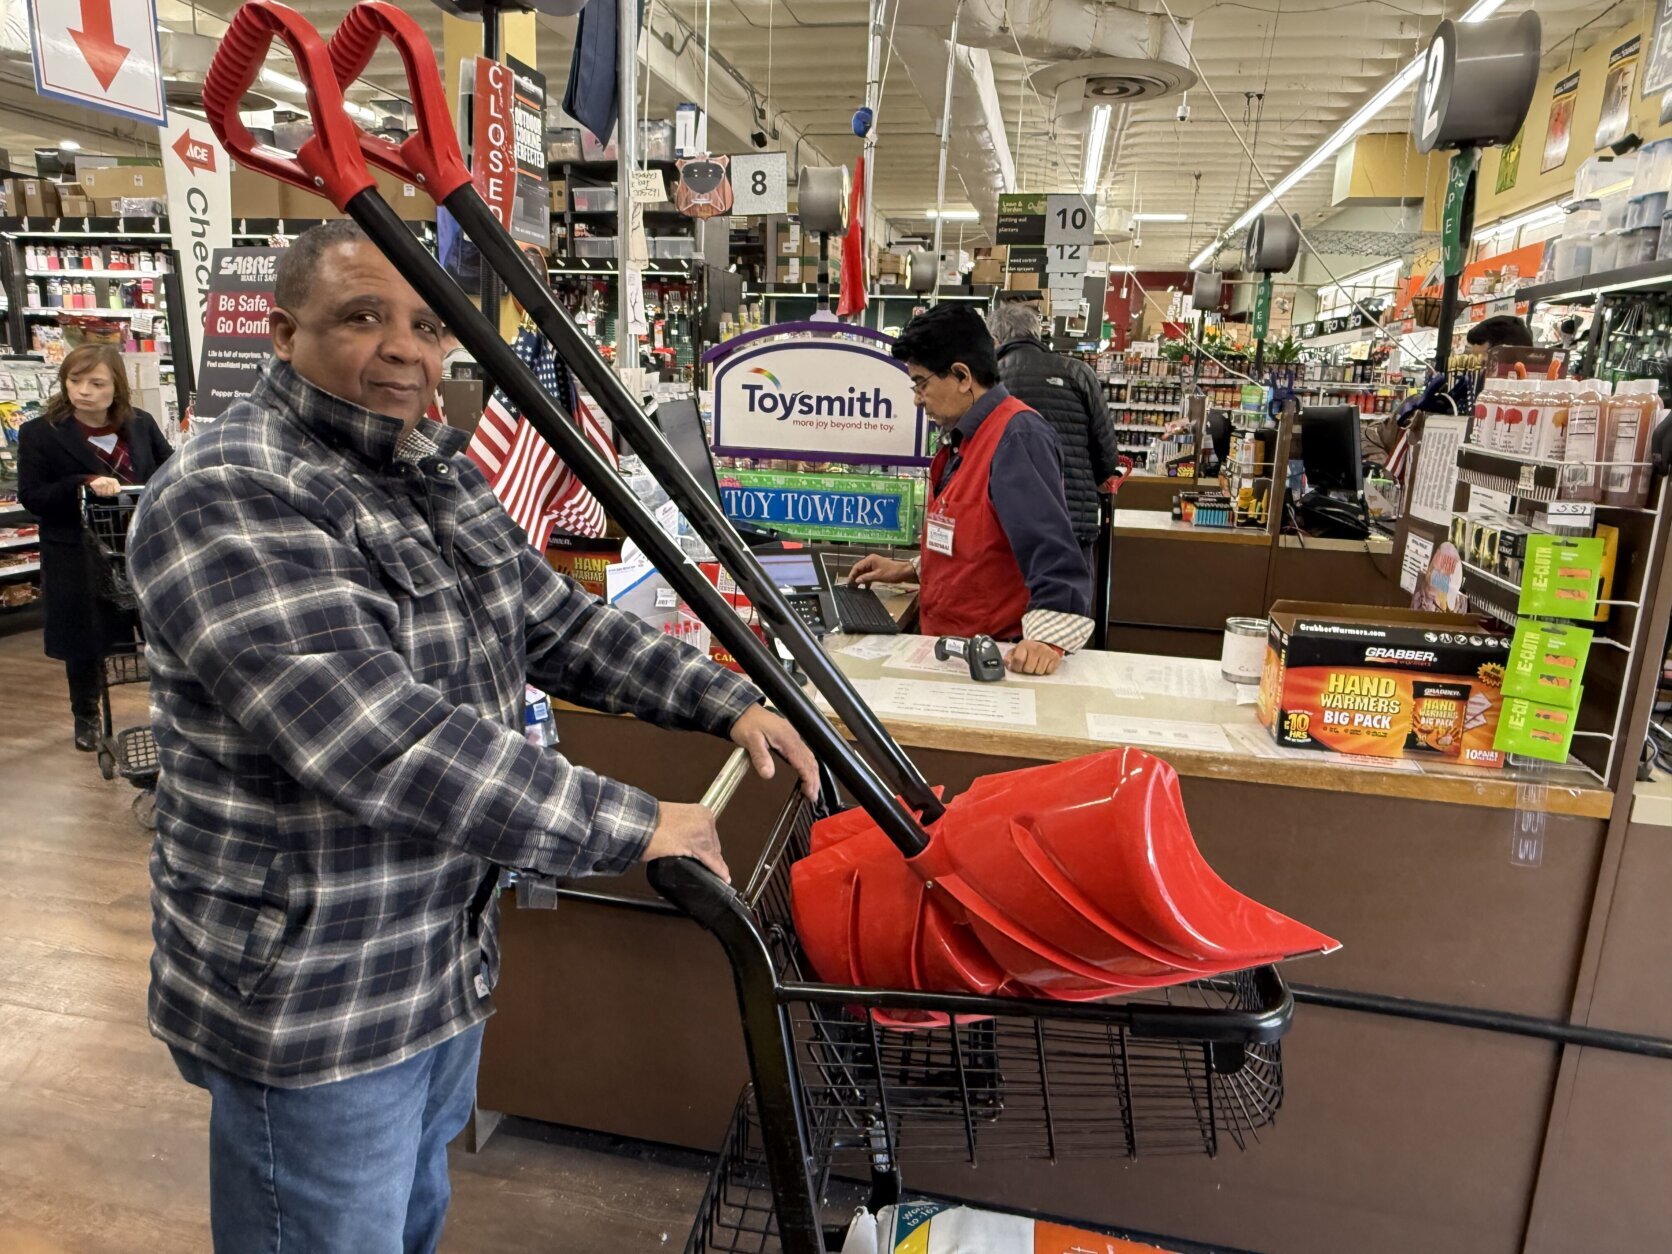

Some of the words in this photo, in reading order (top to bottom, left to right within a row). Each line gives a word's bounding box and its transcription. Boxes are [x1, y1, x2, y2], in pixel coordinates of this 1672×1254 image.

[1422, 36, 1445, 140] 2
[186, 143, 208, 162] ACE
[751, 170, 767, 197] 8
[1056, 208, 1087, 230] 10
[1056, 244, 1081, 260] 12
[219, 256, 277, 275] SABRE
[218, 295, 236, 312] Be
[238, 295, 270, 315] Safe,
[1256, 286, 1265, 334] OPEN
[216, 316, 234, 334] Go
[211, 389, 233, 398] Pepper
[742, 384, 892, 421] Toysmith
[792, 419, 814, 427] more
[816, 419, 828, 430] joy
[830, 420, 862, 431] beyond
[864, 421, 878, 430] the
[725, 490, 775, 518] TOY
[1299, 623, 1386, 637] GrabberWarmers.com
[1365, 646, 1435, 662] GRABBER
[1328, 673, 1396, 698] HAND
[1320, 693, 1400, 714] WARMERS
[1423, 699, 1457, 711] HAND
[1288, 713, 1310, 732] 10
[1323, 710, 1351, 726] BIG
[1353, 713, 1392, 730] PACK
[1289, 730, 1308, 740] HRS
[1466, 749, 1478, 760] 10
